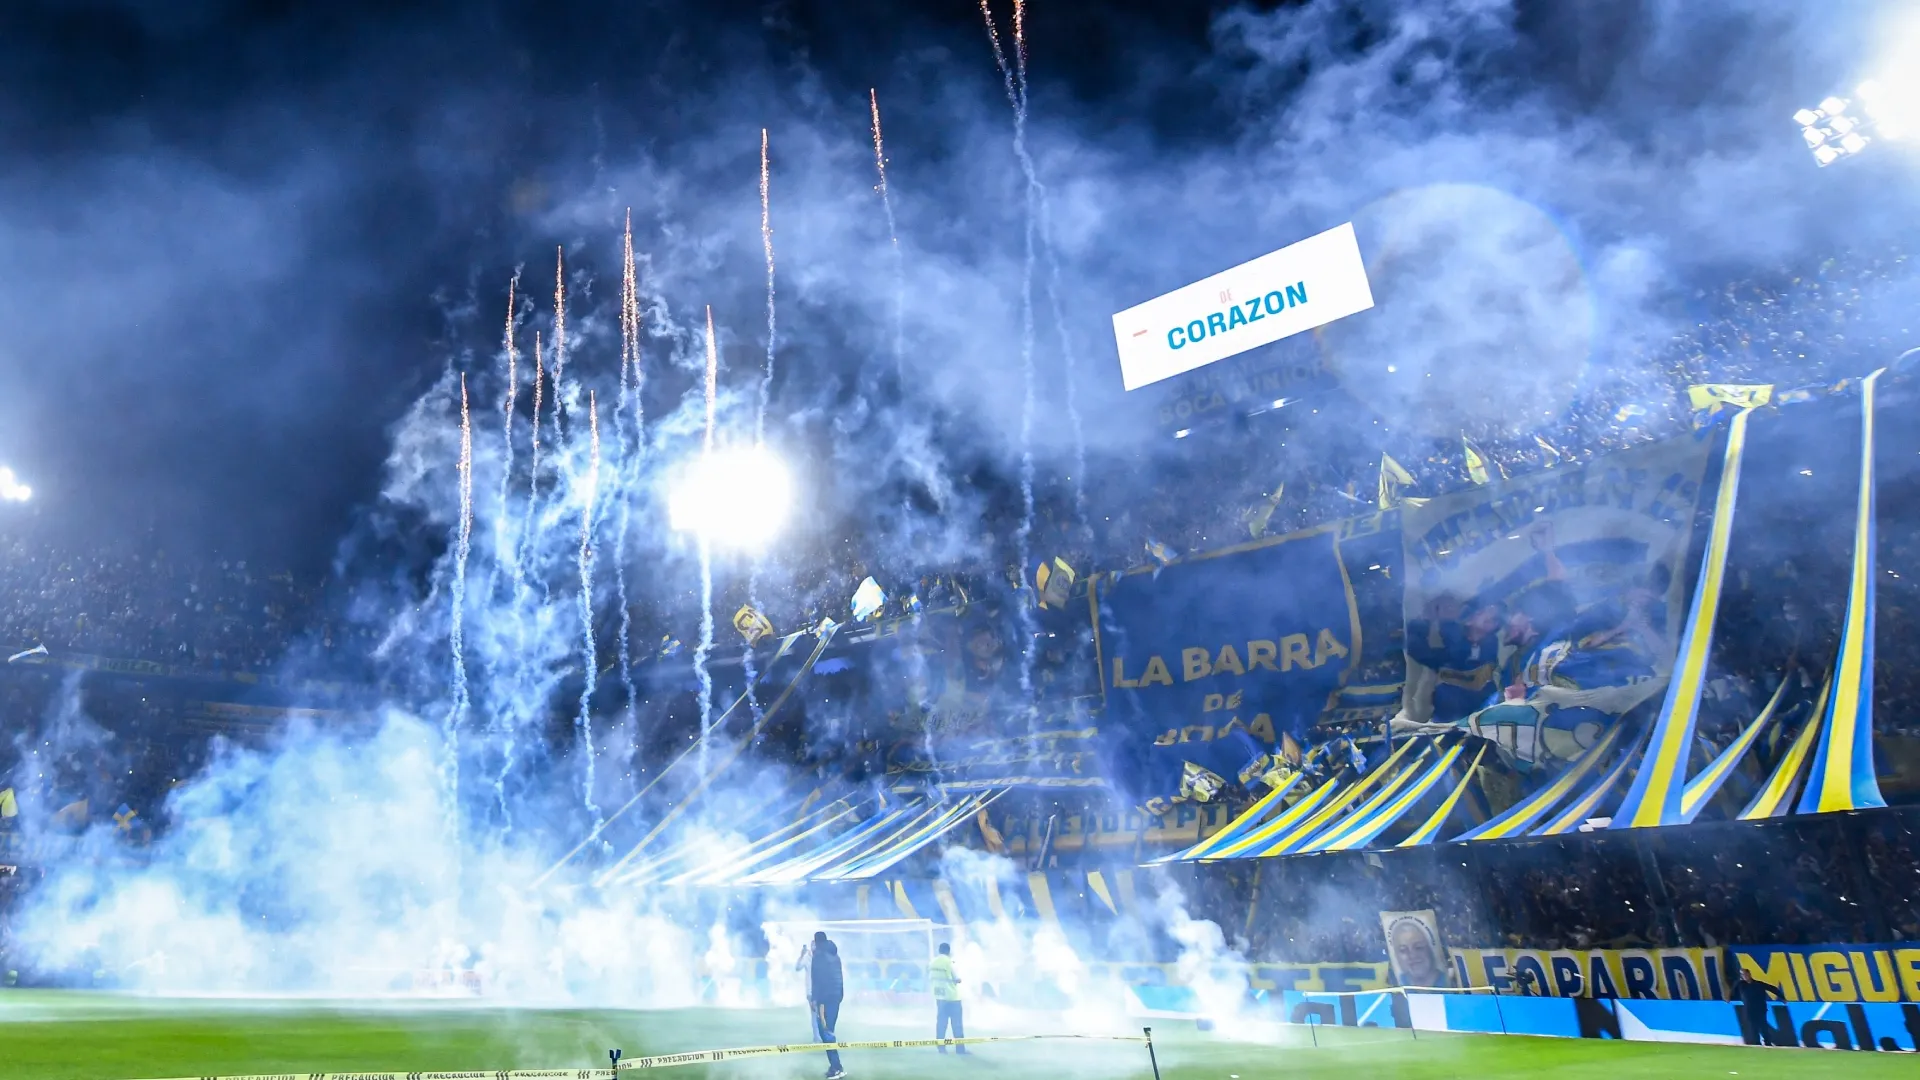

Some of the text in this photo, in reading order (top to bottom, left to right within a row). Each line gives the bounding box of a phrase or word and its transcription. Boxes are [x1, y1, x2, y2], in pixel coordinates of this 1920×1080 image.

[1167, 281, 1308, 350] CORAZON
[1112, 628, 1349, 688] LA BARRA
[1203, 690, 1243, 712] DE
